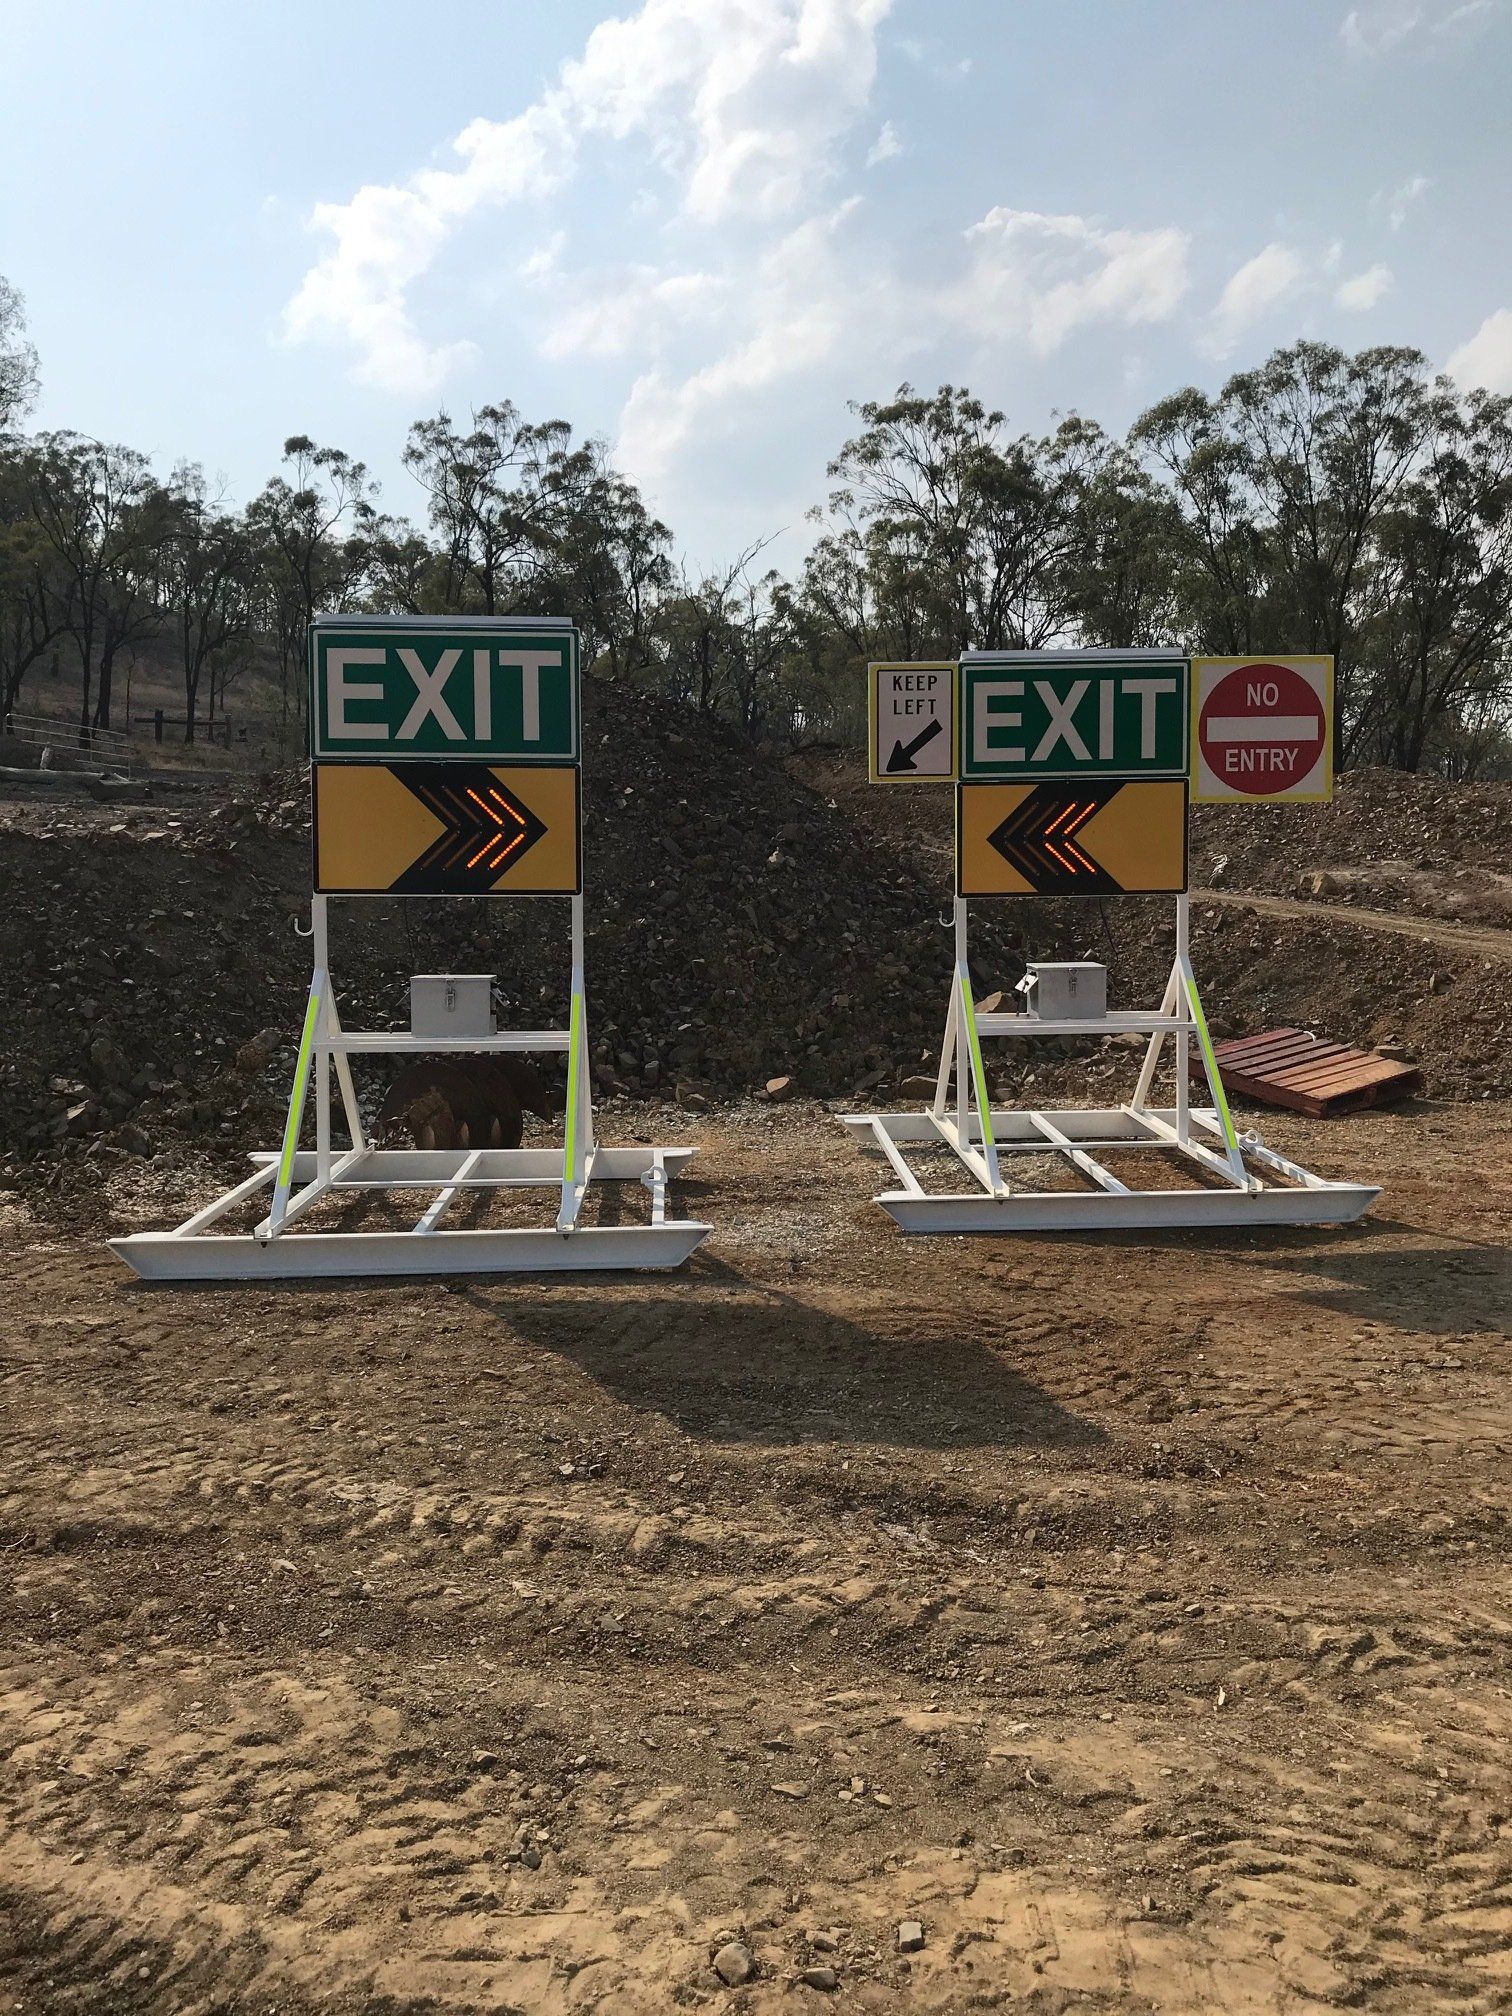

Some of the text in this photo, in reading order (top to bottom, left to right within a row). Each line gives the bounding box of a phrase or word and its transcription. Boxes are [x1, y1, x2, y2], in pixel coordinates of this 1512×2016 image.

[326, 648, 562, 741] EXIT
[892, 675, 938, 692] KEEP
[1246, 682, 1280, 707] NO
[893, 698, 936, 715] LEFT
[973, 678, 1177, 762] EXIT
[1225, 748, 1299, 772] ENTRY
